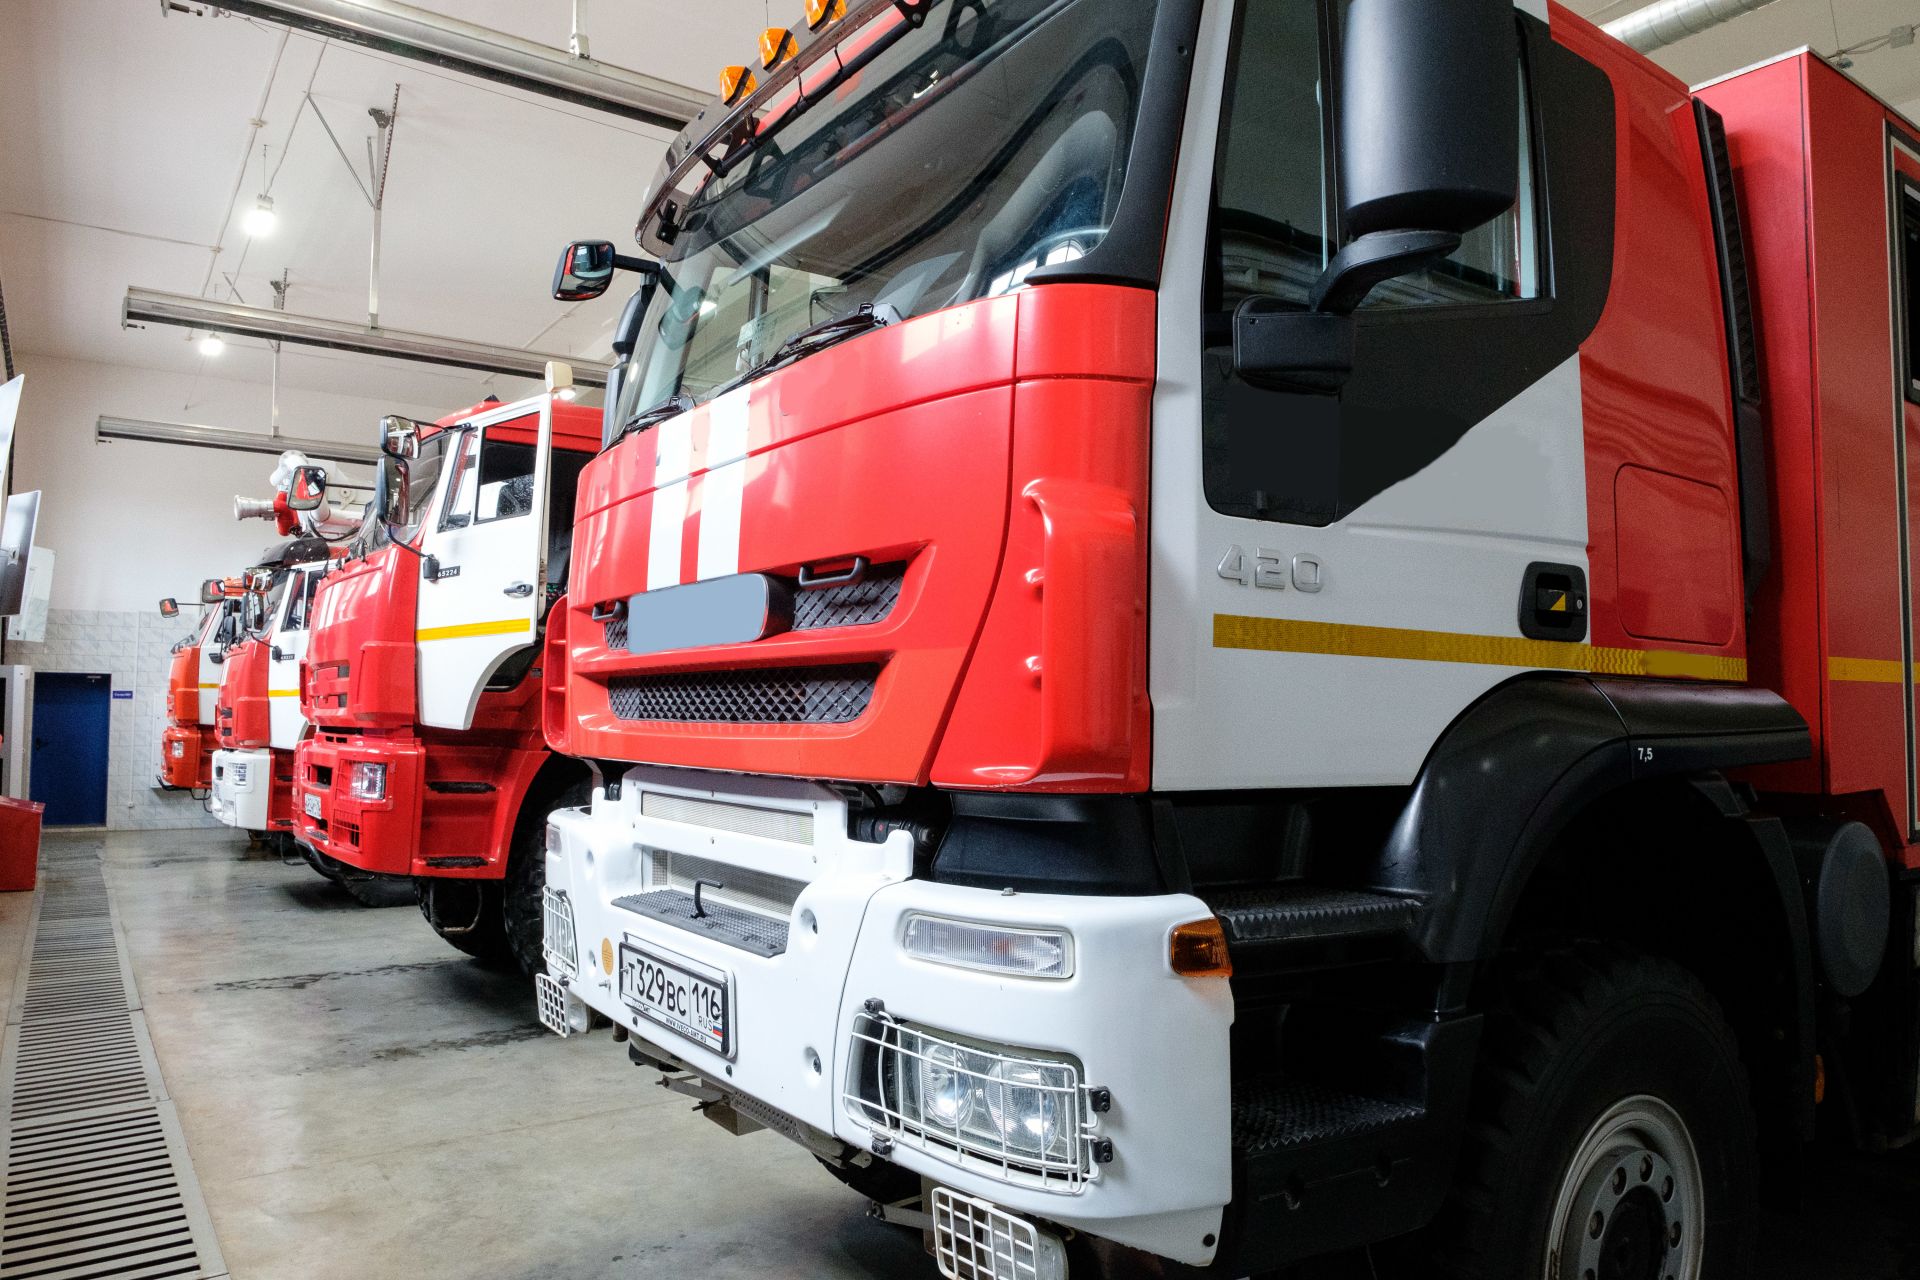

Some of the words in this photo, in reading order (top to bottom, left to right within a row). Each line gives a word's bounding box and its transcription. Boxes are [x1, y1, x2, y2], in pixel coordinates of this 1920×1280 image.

[1217, 544, 1324, 594] 420
[1637, 747, 1653, 763] 7,5
[691, 982, 721, 1021] 116
[698, 1015, 713, 1032] RUS
